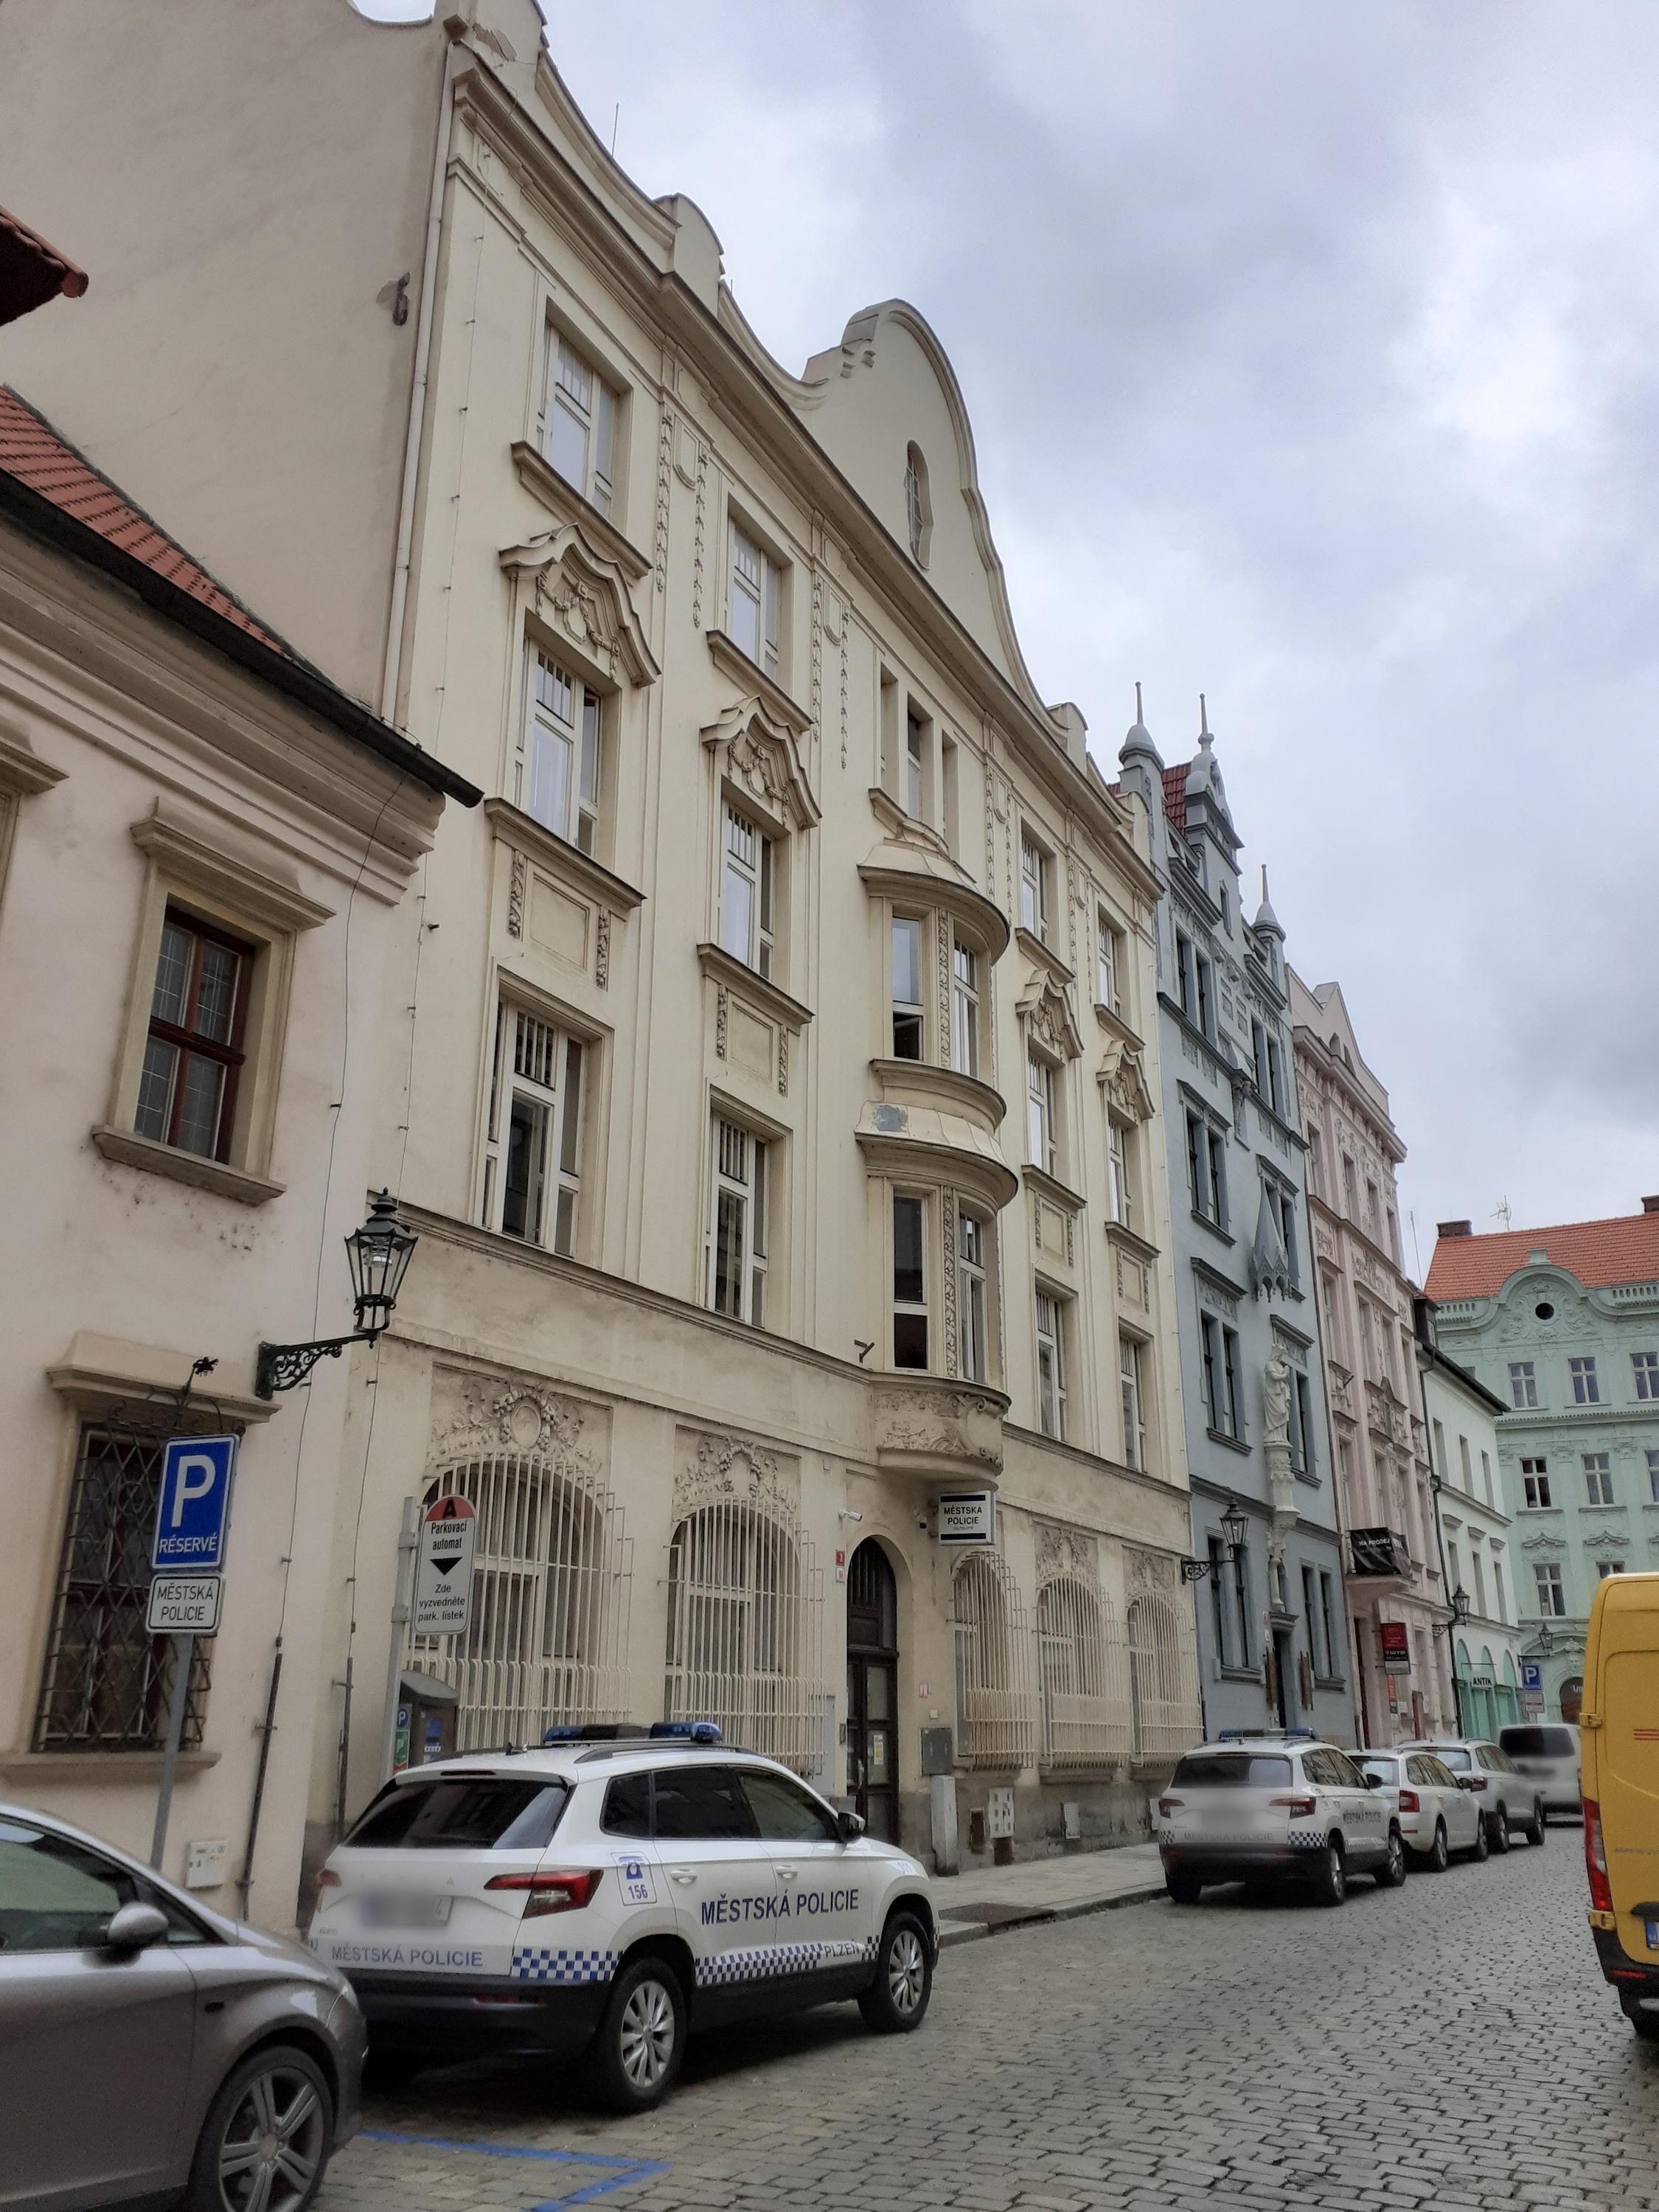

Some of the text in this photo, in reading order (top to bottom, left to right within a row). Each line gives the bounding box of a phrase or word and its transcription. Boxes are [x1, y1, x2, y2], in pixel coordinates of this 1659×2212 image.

[171, 1454, 216, 1527] P
[442, 1498, 457, 1518] A
[944, 1505, 982, 1515] MĚSTSKÁ
[431, 1520, 467, 1534] Parkovací
[947, 1517, 979, 1525] POLICIE
[159, 1532, 218, 1554] RÉSERVÉ
[432, 1537, 462, 1551] automat
[157, 1582, 215, 1601] MĚSTSKÁ
[435, 1584, 451, 1593] Zde
[419, 1596, 465, 1609] vyzvedněte
[161, 1606, 205, 1621] POLICIE
[418, 1610, 464, 1623] park. lístek
[1472, 1677, 1492, 1686] ANTIK
[1526, 1667, 1537, 1683] P
[398, 1711, 406, 1725] P
[628, 1884, 648, 1900] 156
[701, 1888, 859, 1925] MĚSTSKÁ POLICIE
[824, 1937, 860, 1958] PLZEŇ
[409, 1950, 484, 1967] POLICIE
